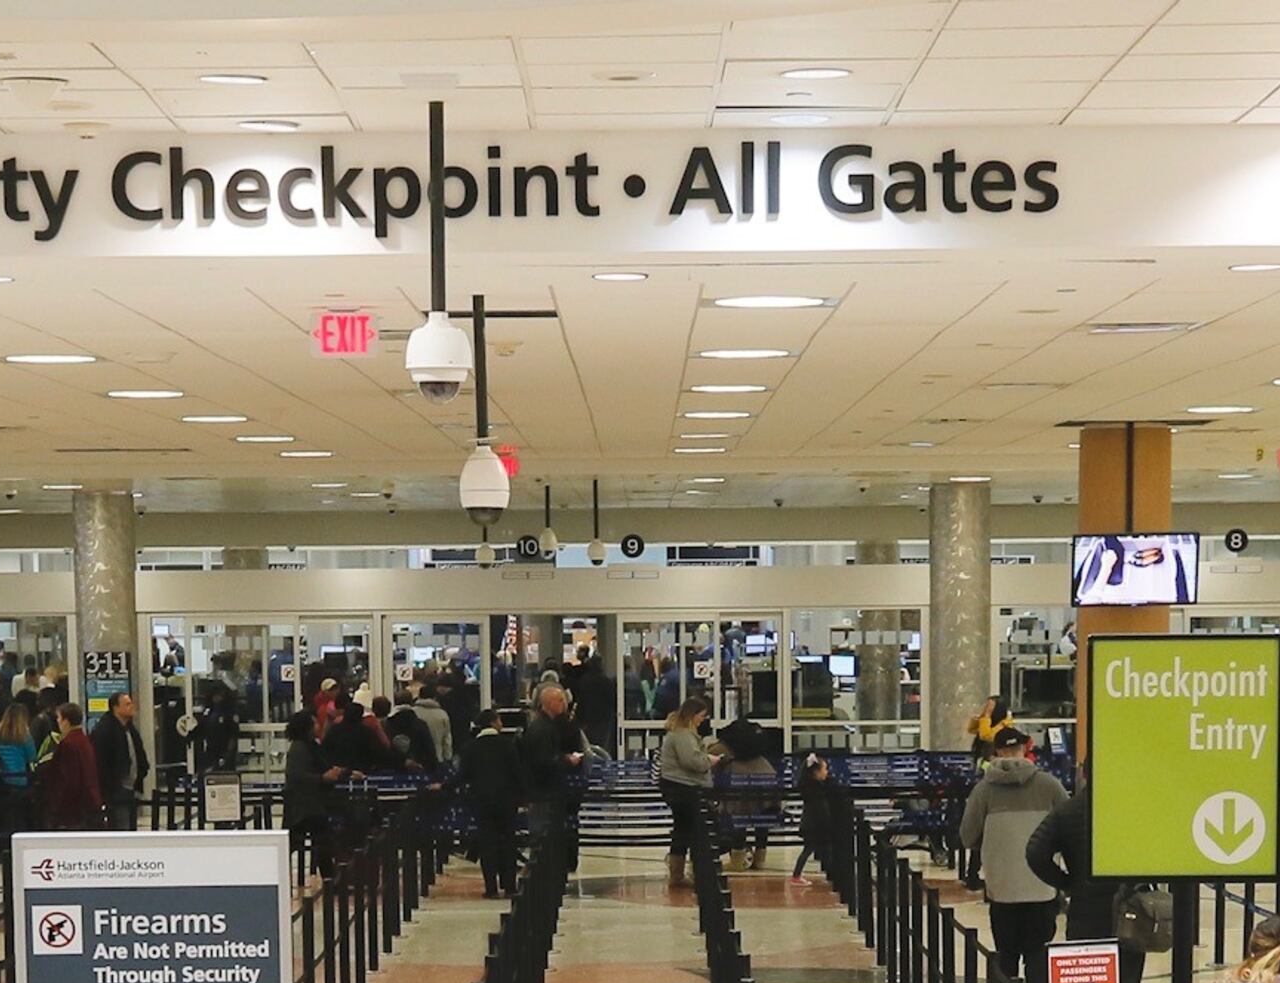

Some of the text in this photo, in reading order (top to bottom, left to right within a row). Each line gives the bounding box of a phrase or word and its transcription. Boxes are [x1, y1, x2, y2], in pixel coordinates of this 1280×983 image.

[111, 146, 600, 238] Checkpoint
[669, 141, 781, 217] All
[817, 143, 1060, 215] Gates
[321, 315, 369, 353] EXIT
[519, 540, 537, 553] 10
[627, 538, 639, 555] 9
[1231, 533, 1242, 548] 8
[86, 652, 128, 673] 3-1-1
[1105, 657, 1268, 704] Checkpoint
[1190, 713, 1267, 758] Entry
[57, 858, 165, 872] Hartsfield-Jackson
[87, 871, 135, 879] International
[137, 870, 165, 879] Airport
[93, 908, 226, 935] Firearms
[93, 940, 269, 960] Are Not Permitted
[1060, 966, 1107, 975] PASSENGERS
[1060, 976, 1090, 983] BEYOND
